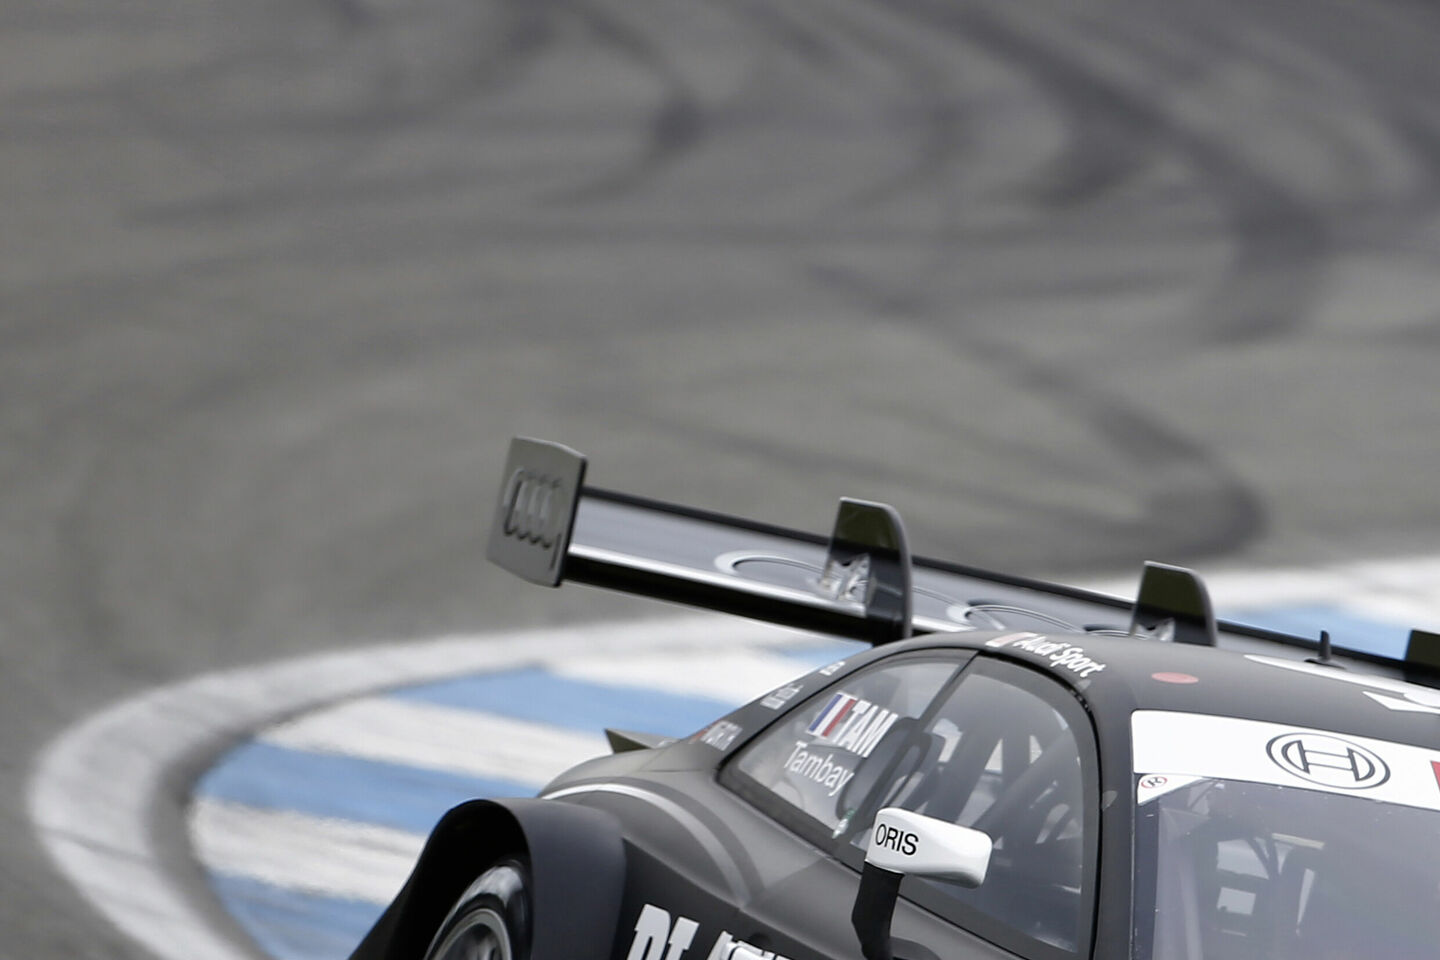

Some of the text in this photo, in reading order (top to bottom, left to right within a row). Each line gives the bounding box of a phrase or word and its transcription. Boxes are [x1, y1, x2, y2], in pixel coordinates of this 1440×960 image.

[1012, 635, 1107, 678] Audi Sport
[832, 699, 899, 758] TAM
[783, 740, 855, 796] Tambay
[875, 823, 919, 856] ORIS
